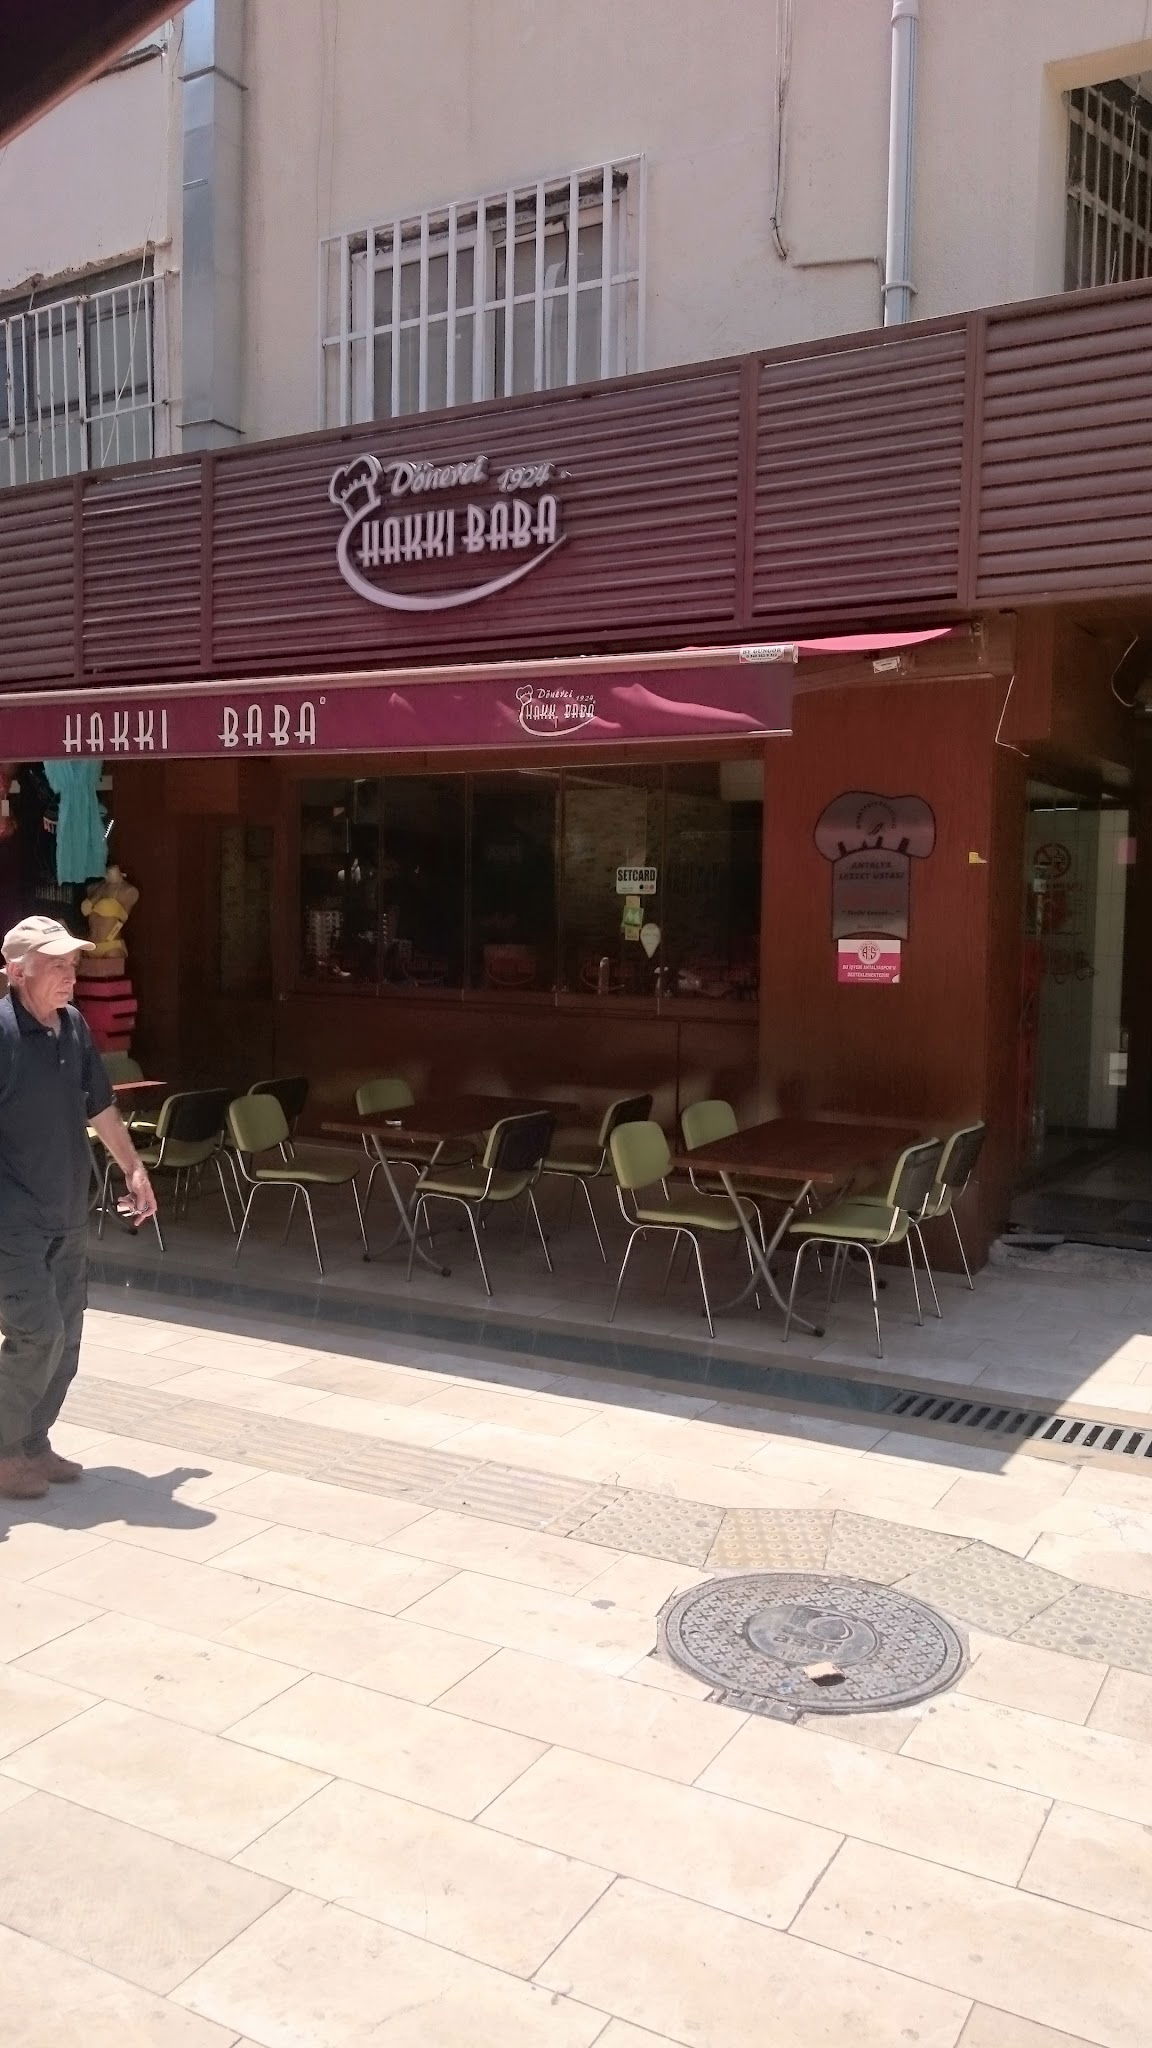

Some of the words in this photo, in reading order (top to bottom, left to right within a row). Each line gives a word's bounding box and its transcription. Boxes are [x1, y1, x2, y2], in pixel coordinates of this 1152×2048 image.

[497, 463, 556, 493] 1924
[357, 508, 455, 568] HAKKI
[461, 494, 558, 553] BABA
[563, 703, 595, 719] BABA
[62, 709, 168, 752] HAKKI
[617, 869, 656, 881] SETCARD
